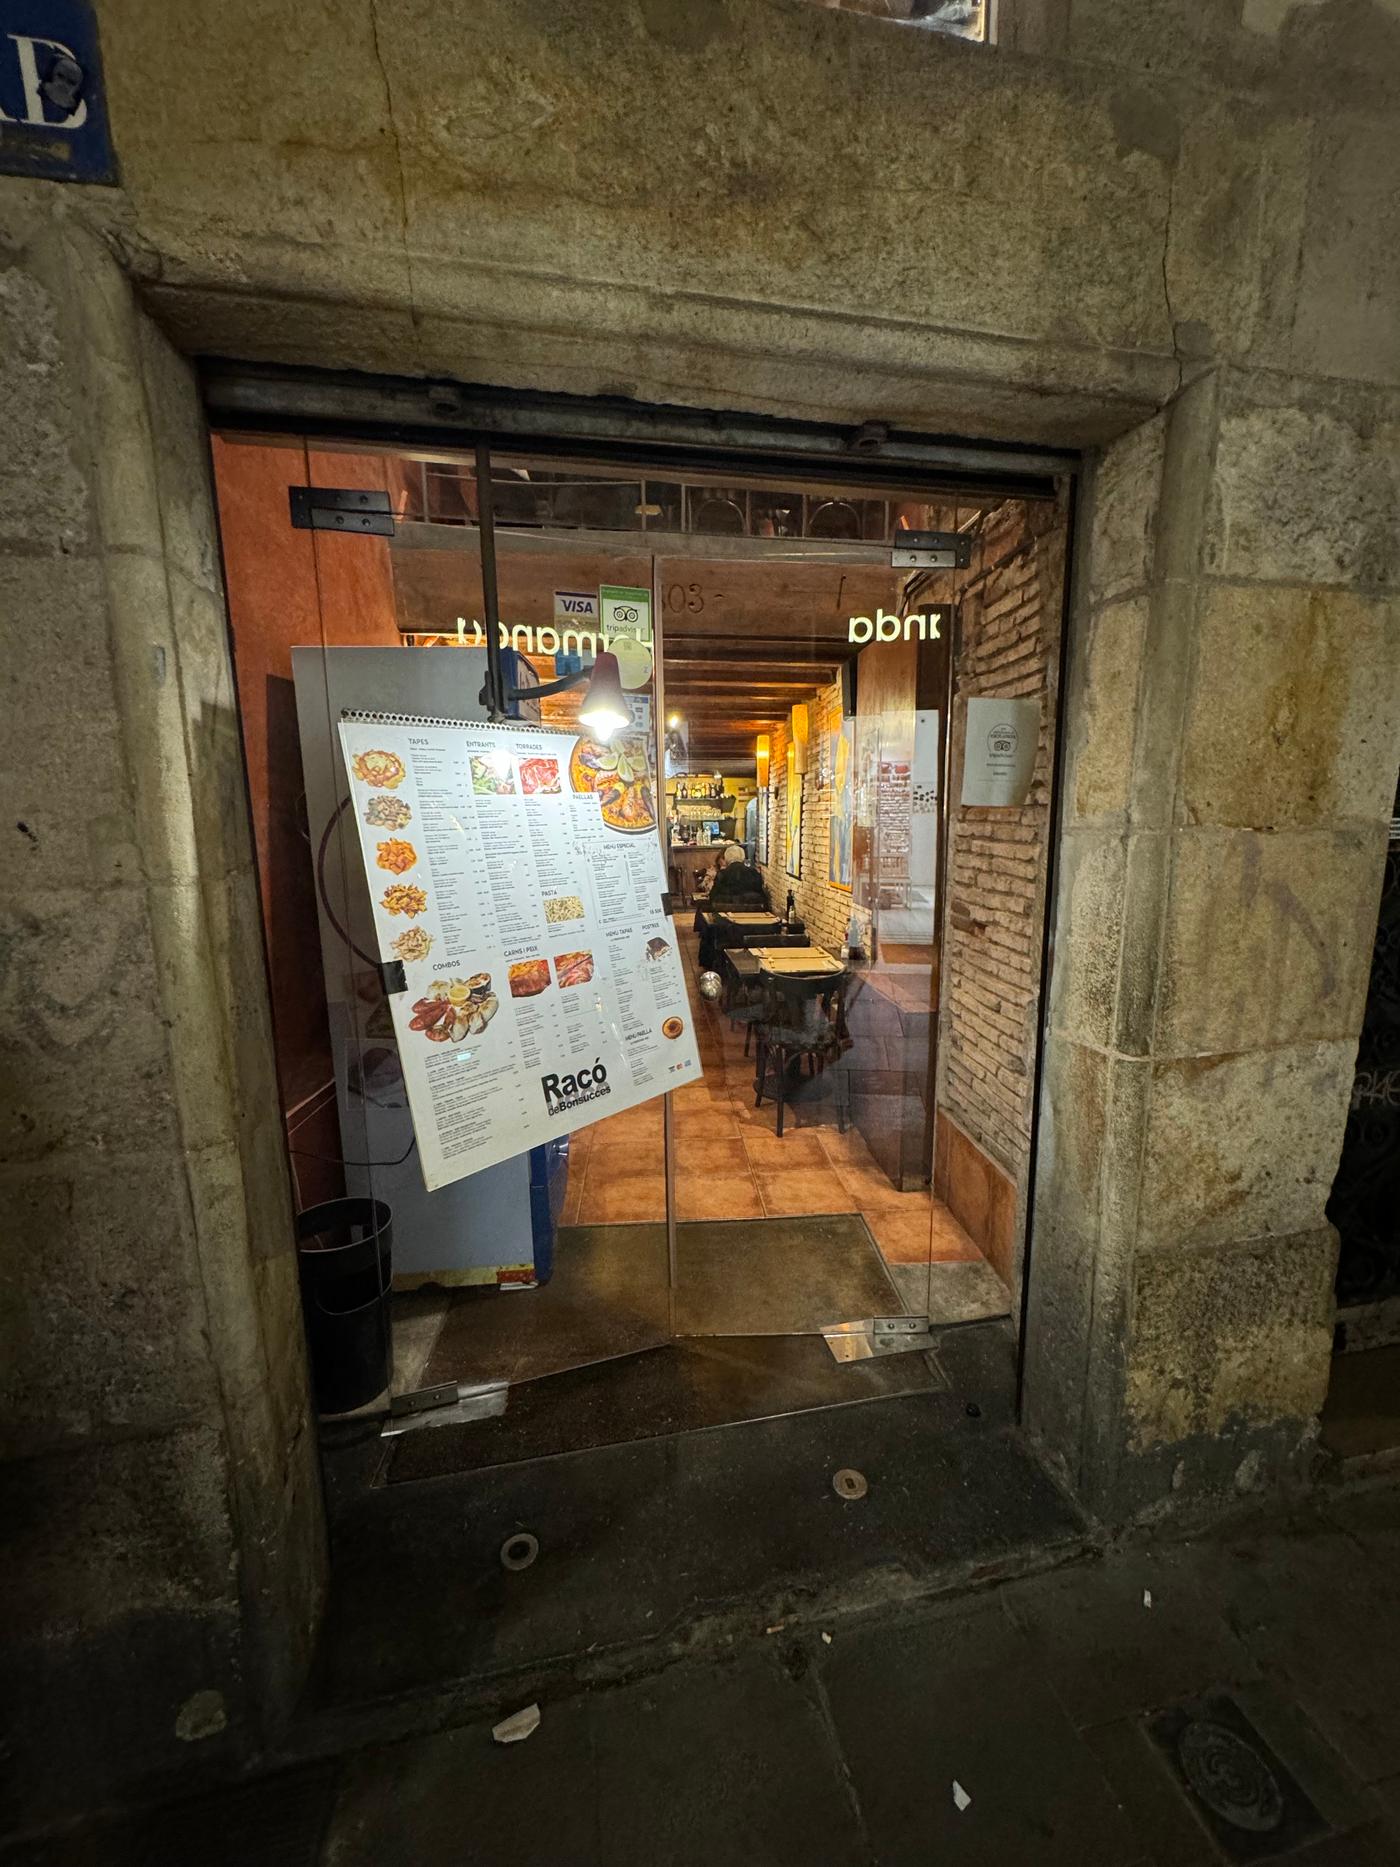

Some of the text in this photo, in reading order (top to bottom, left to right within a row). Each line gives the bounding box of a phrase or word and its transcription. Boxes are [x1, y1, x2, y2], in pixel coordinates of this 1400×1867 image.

[561, 599, 593, 614] VISA
[408, 737, 429, 746] TAPES
[466, 740, 496, 749] ENTRANTS
[432, 959, 461, 971] COMBOS
[541, 1056, 607, 1103] Racó
